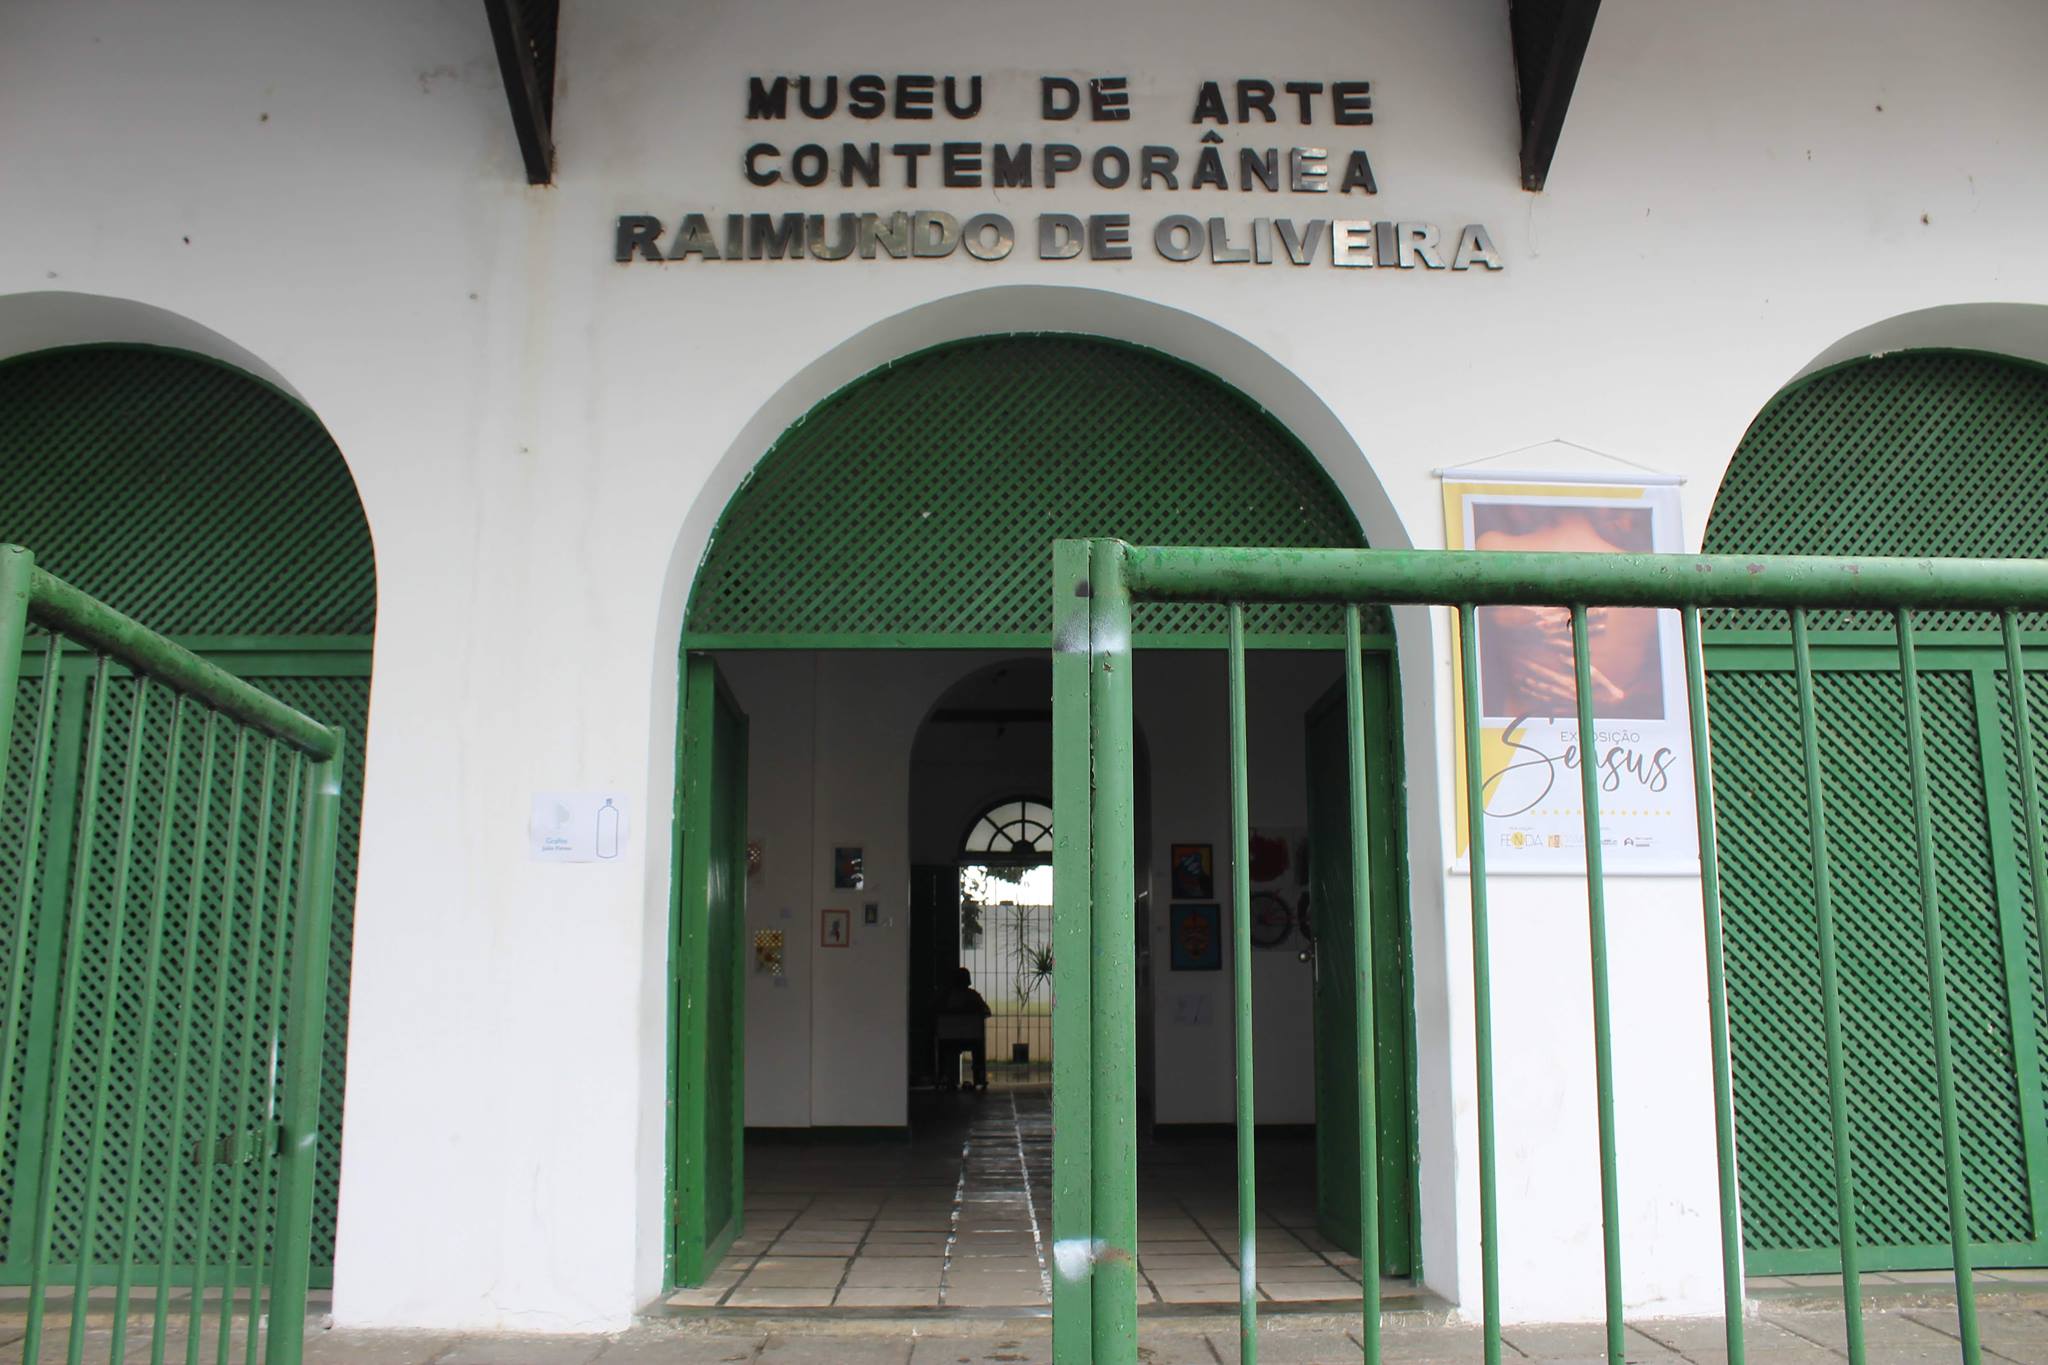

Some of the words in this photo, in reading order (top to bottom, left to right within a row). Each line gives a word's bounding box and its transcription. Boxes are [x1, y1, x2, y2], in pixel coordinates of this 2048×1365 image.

[746, 74, 982, 120] MUSEU
[1040, 76, 1131, 121] DE
[1192, 79, 1374, 125] ARTE
[744, 130, 1378, 195] CONTEMPORÂNEA
[615, 210, 1016, 262] RAIMUNDO
[1038, 213, 1133, 262] DE
[1154, 213, 1504, 271] OLIVEIRA
[1480, 712, 1677, 818] Sesus
[1560, 729, 1641, 745] EXSIÇÃO
